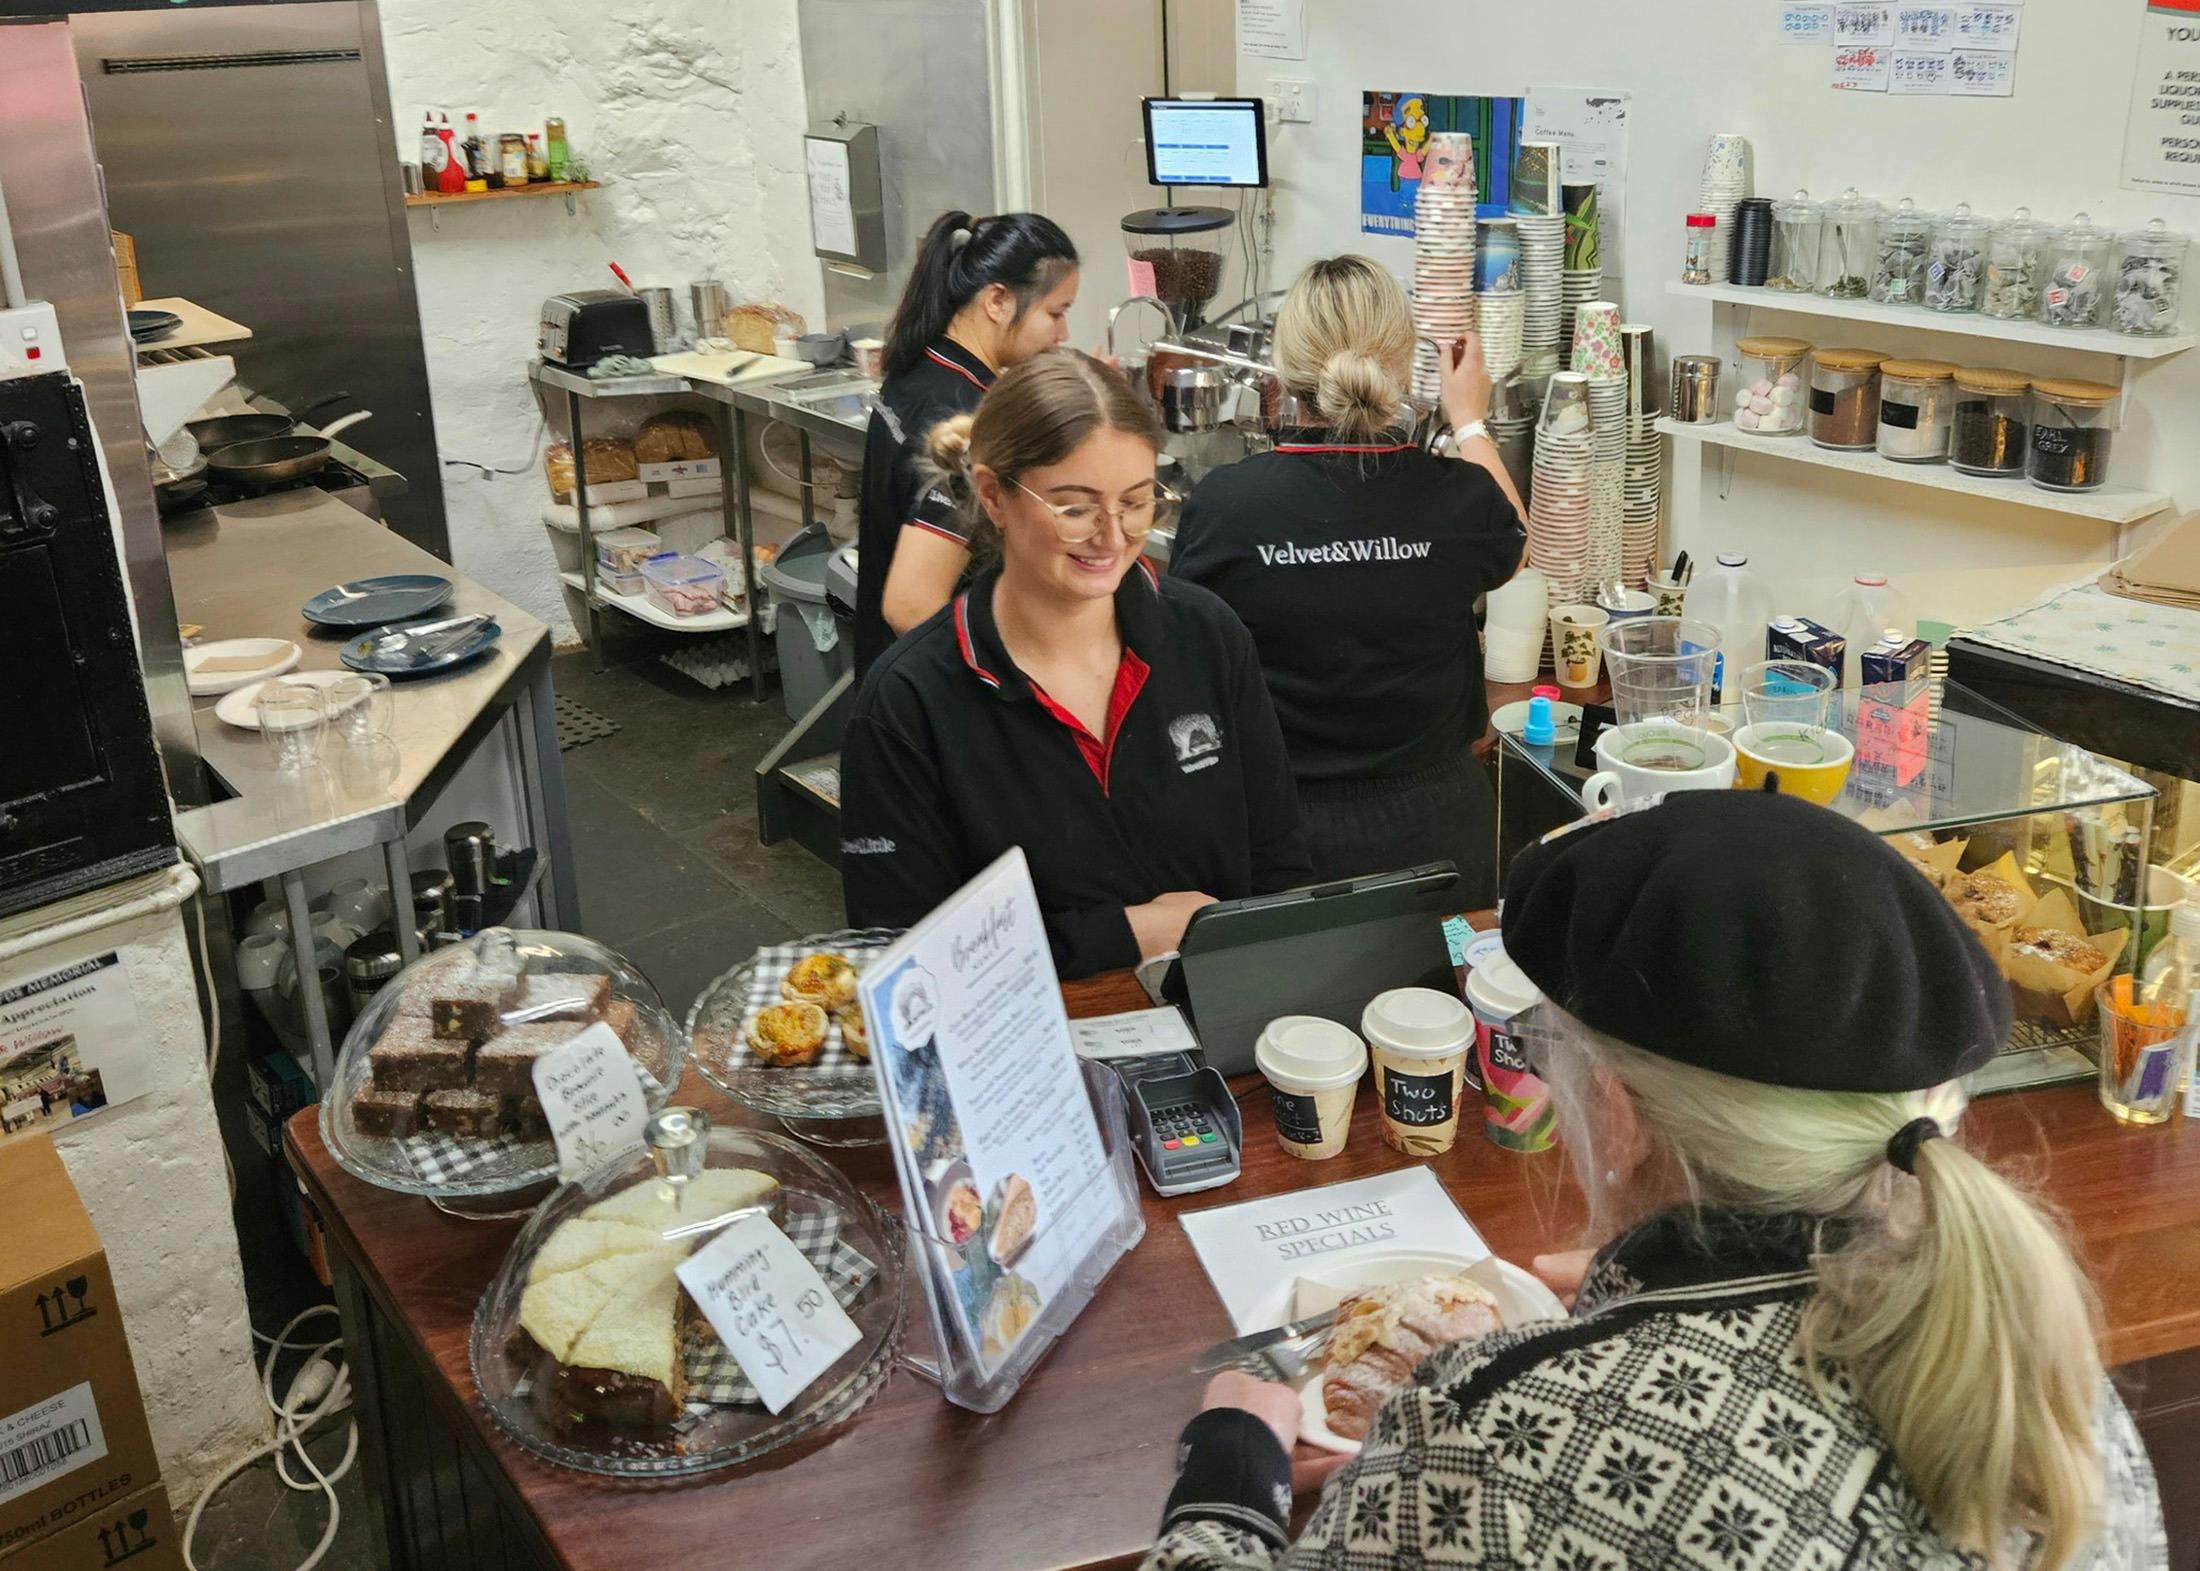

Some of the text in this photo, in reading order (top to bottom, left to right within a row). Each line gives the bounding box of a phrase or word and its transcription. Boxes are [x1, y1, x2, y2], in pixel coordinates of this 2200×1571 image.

[1257, 536, 1431, 566] Velvet&Willow
[27, 957, 103, 995] MEMORIAL
[2, 984, 96, 1024] Appreciation
[1272, 1095, 1296, 1112] ne
[1389, 1077, 1437, 1101] Two
[1256, 1200, 1392, 1241] RED WINE
[1278, 1221, 1397, 1258] SPECIALS
[16, 1399, 67, 1427] CHEESE
[50, 1473, 132, 1523] BOTTLES
